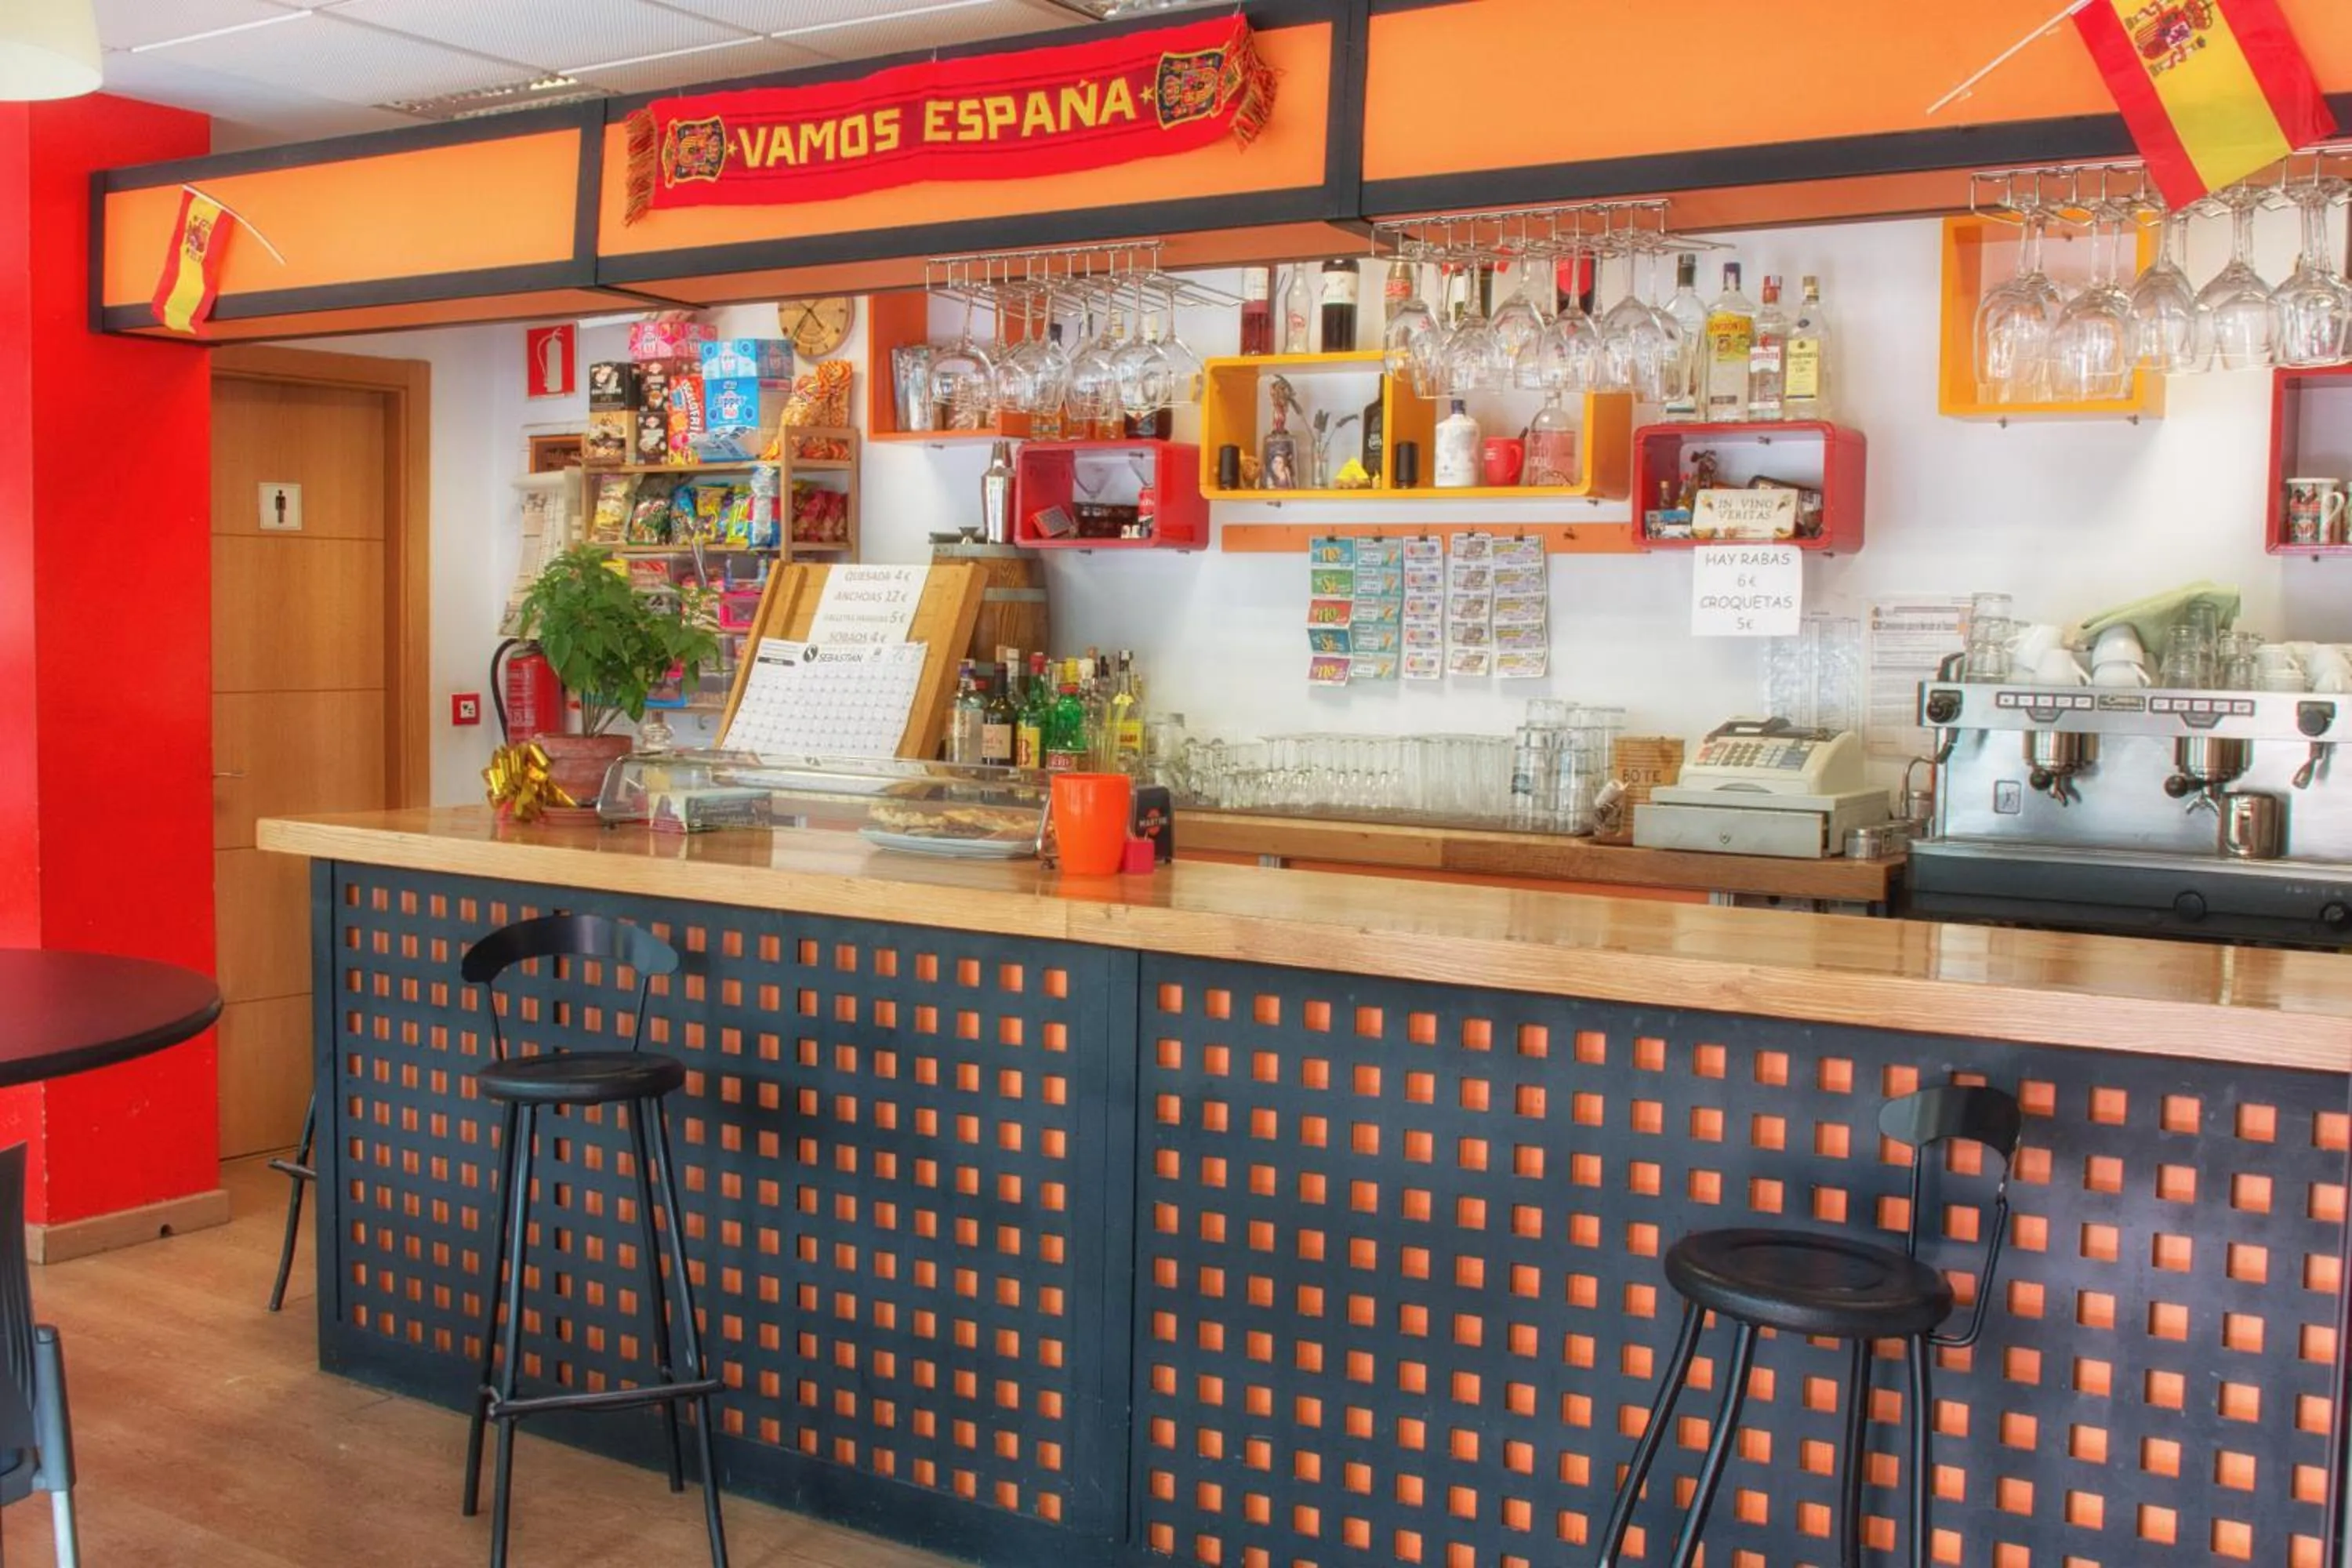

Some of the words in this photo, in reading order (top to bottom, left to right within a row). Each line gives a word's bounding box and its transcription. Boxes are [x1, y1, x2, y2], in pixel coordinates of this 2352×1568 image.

[737, 107, 901, 169] VAMOS
[924, 76, 1137, 142] ESPAÑA
[1741, 498, 1773, 509] VINO
[1718, 510, 1772, 520] VERITAS
[1705, 552, 1737, 566] HAY
[1740, 552, 1791, 565] RABAS
[833, 590, 883, 602] ANCHOAS
[1700, 595, 1794, 611] CROQUETAS
[1622, 768, 1662, 783] BOTE
